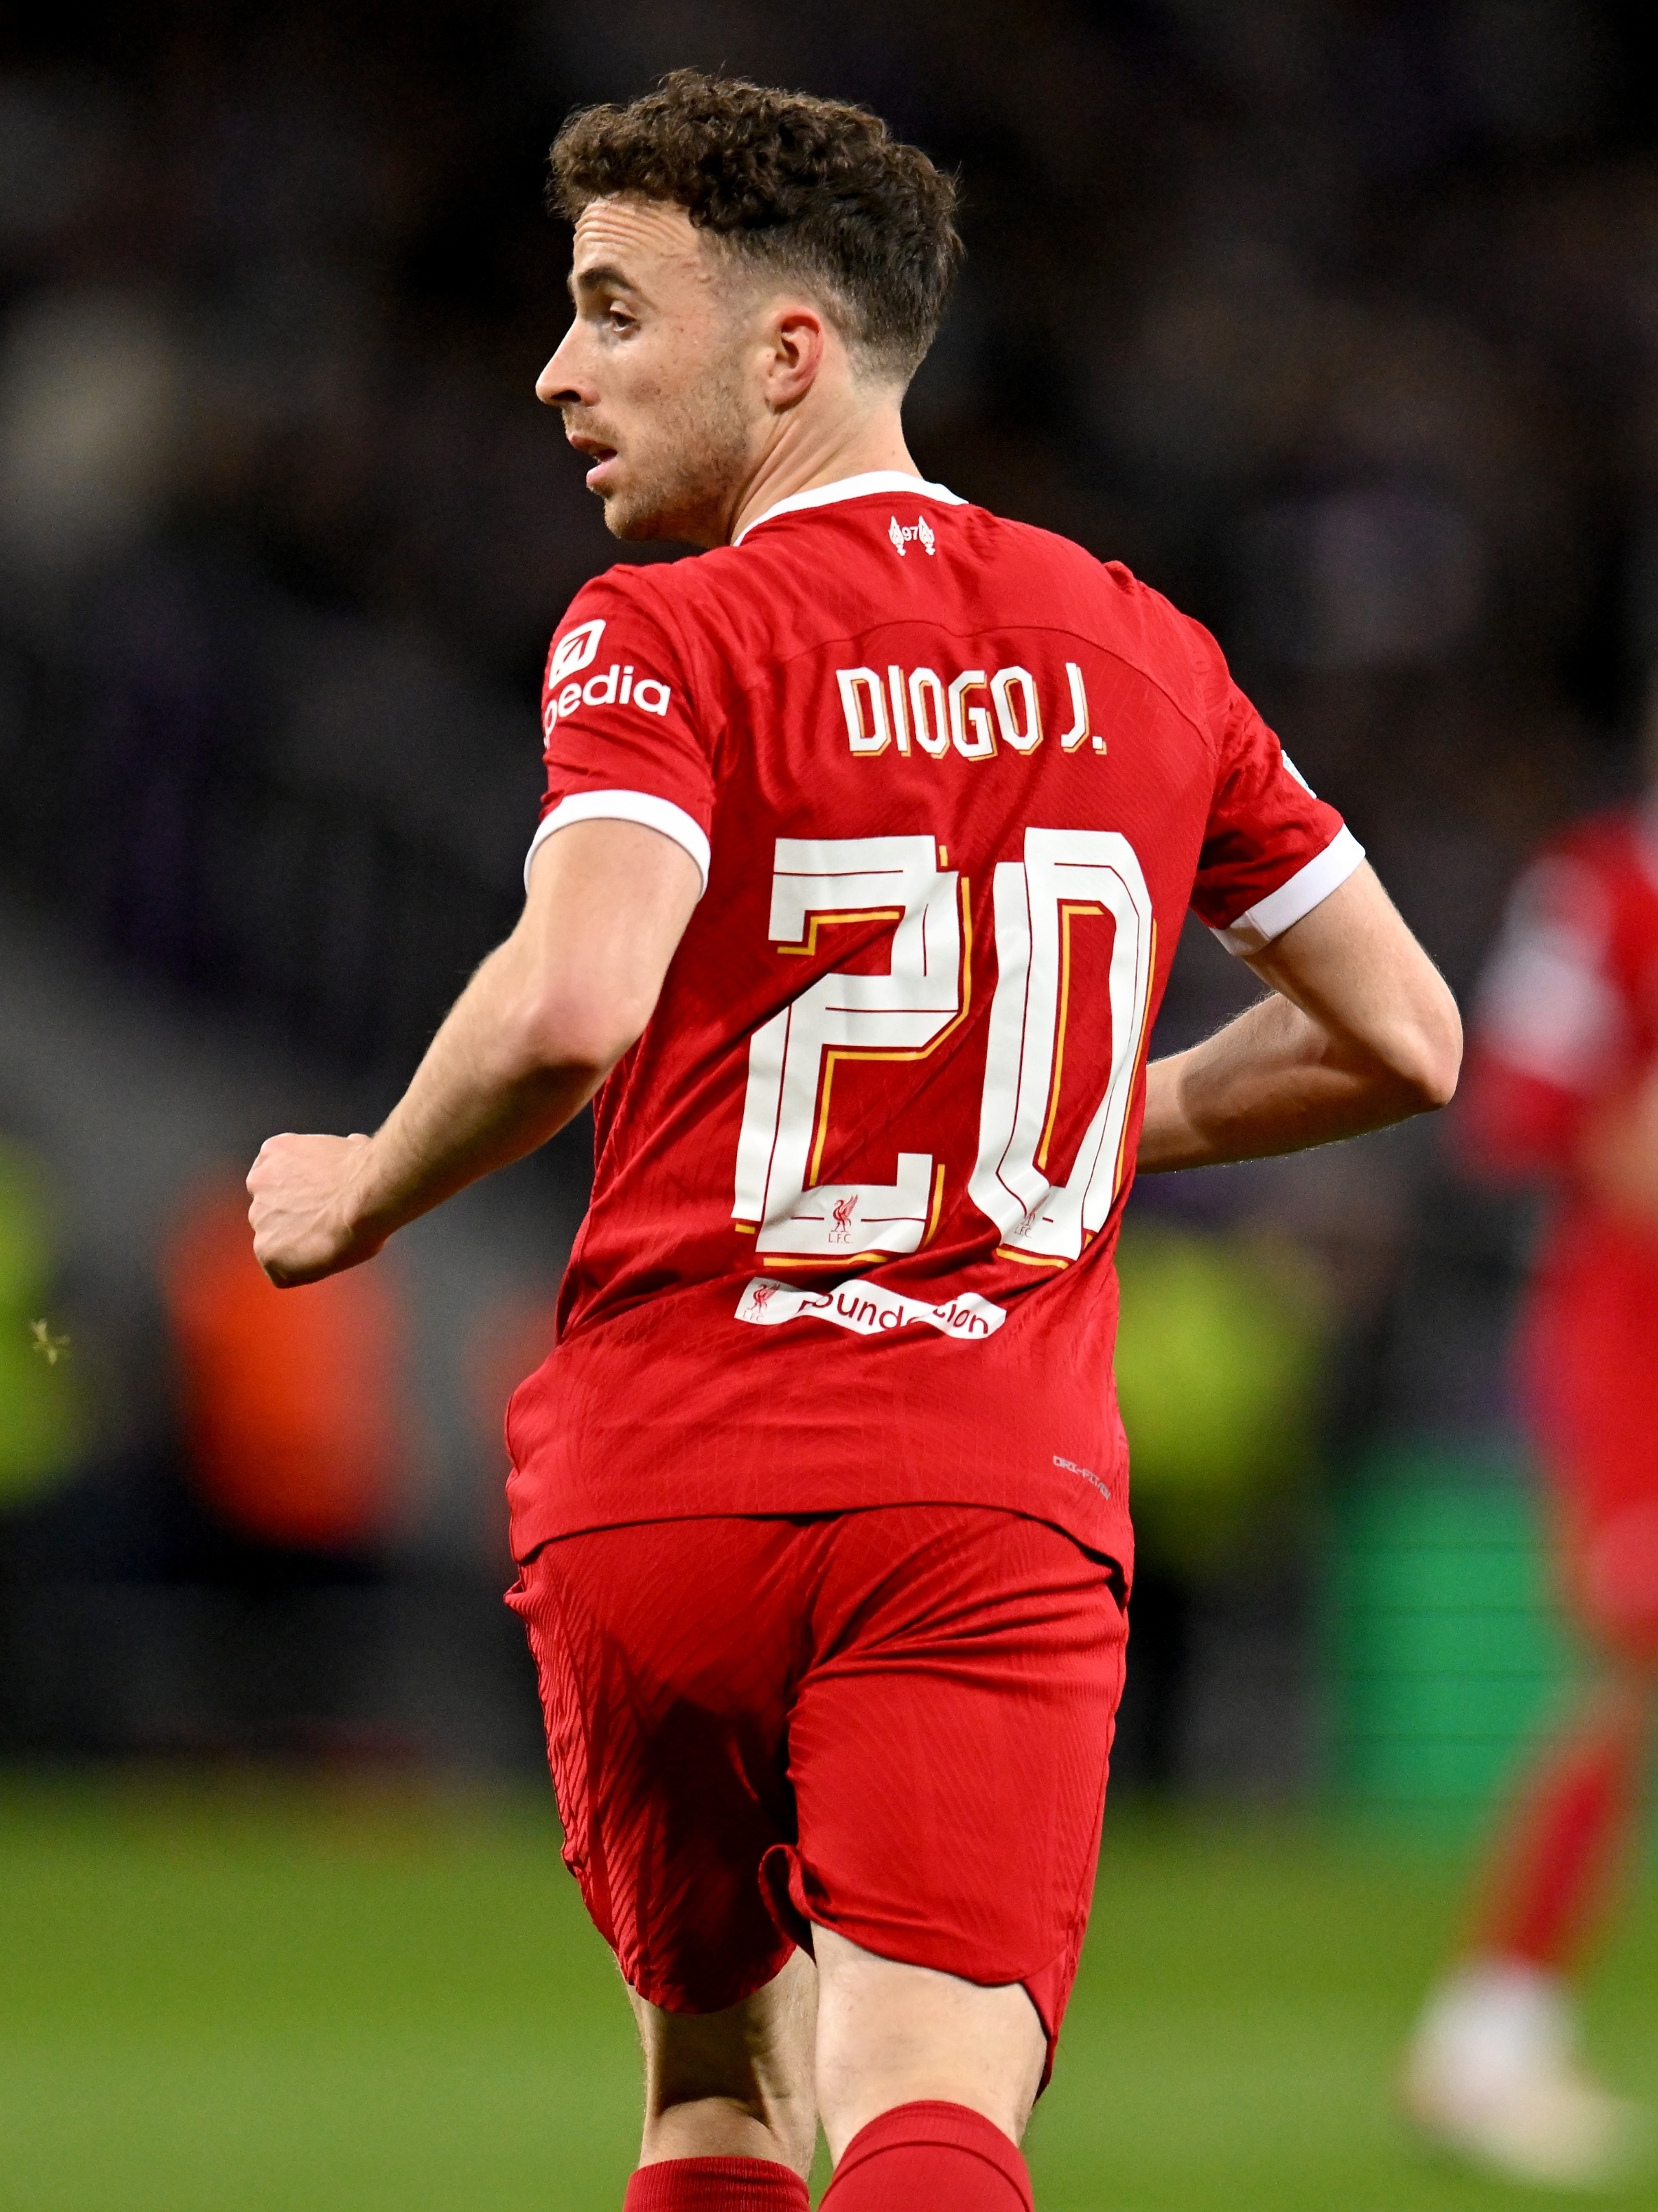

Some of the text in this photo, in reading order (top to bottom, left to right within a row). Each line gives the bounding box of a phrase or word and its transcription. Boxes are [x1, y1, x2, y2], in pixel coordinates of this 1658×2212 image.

[901, 526, 918, 542] 97
[836, 662, 1107, 761] DIOGO J.
[731, 827, 1156, 1269] 20
[796, 1293, 988, 1334] oundion
